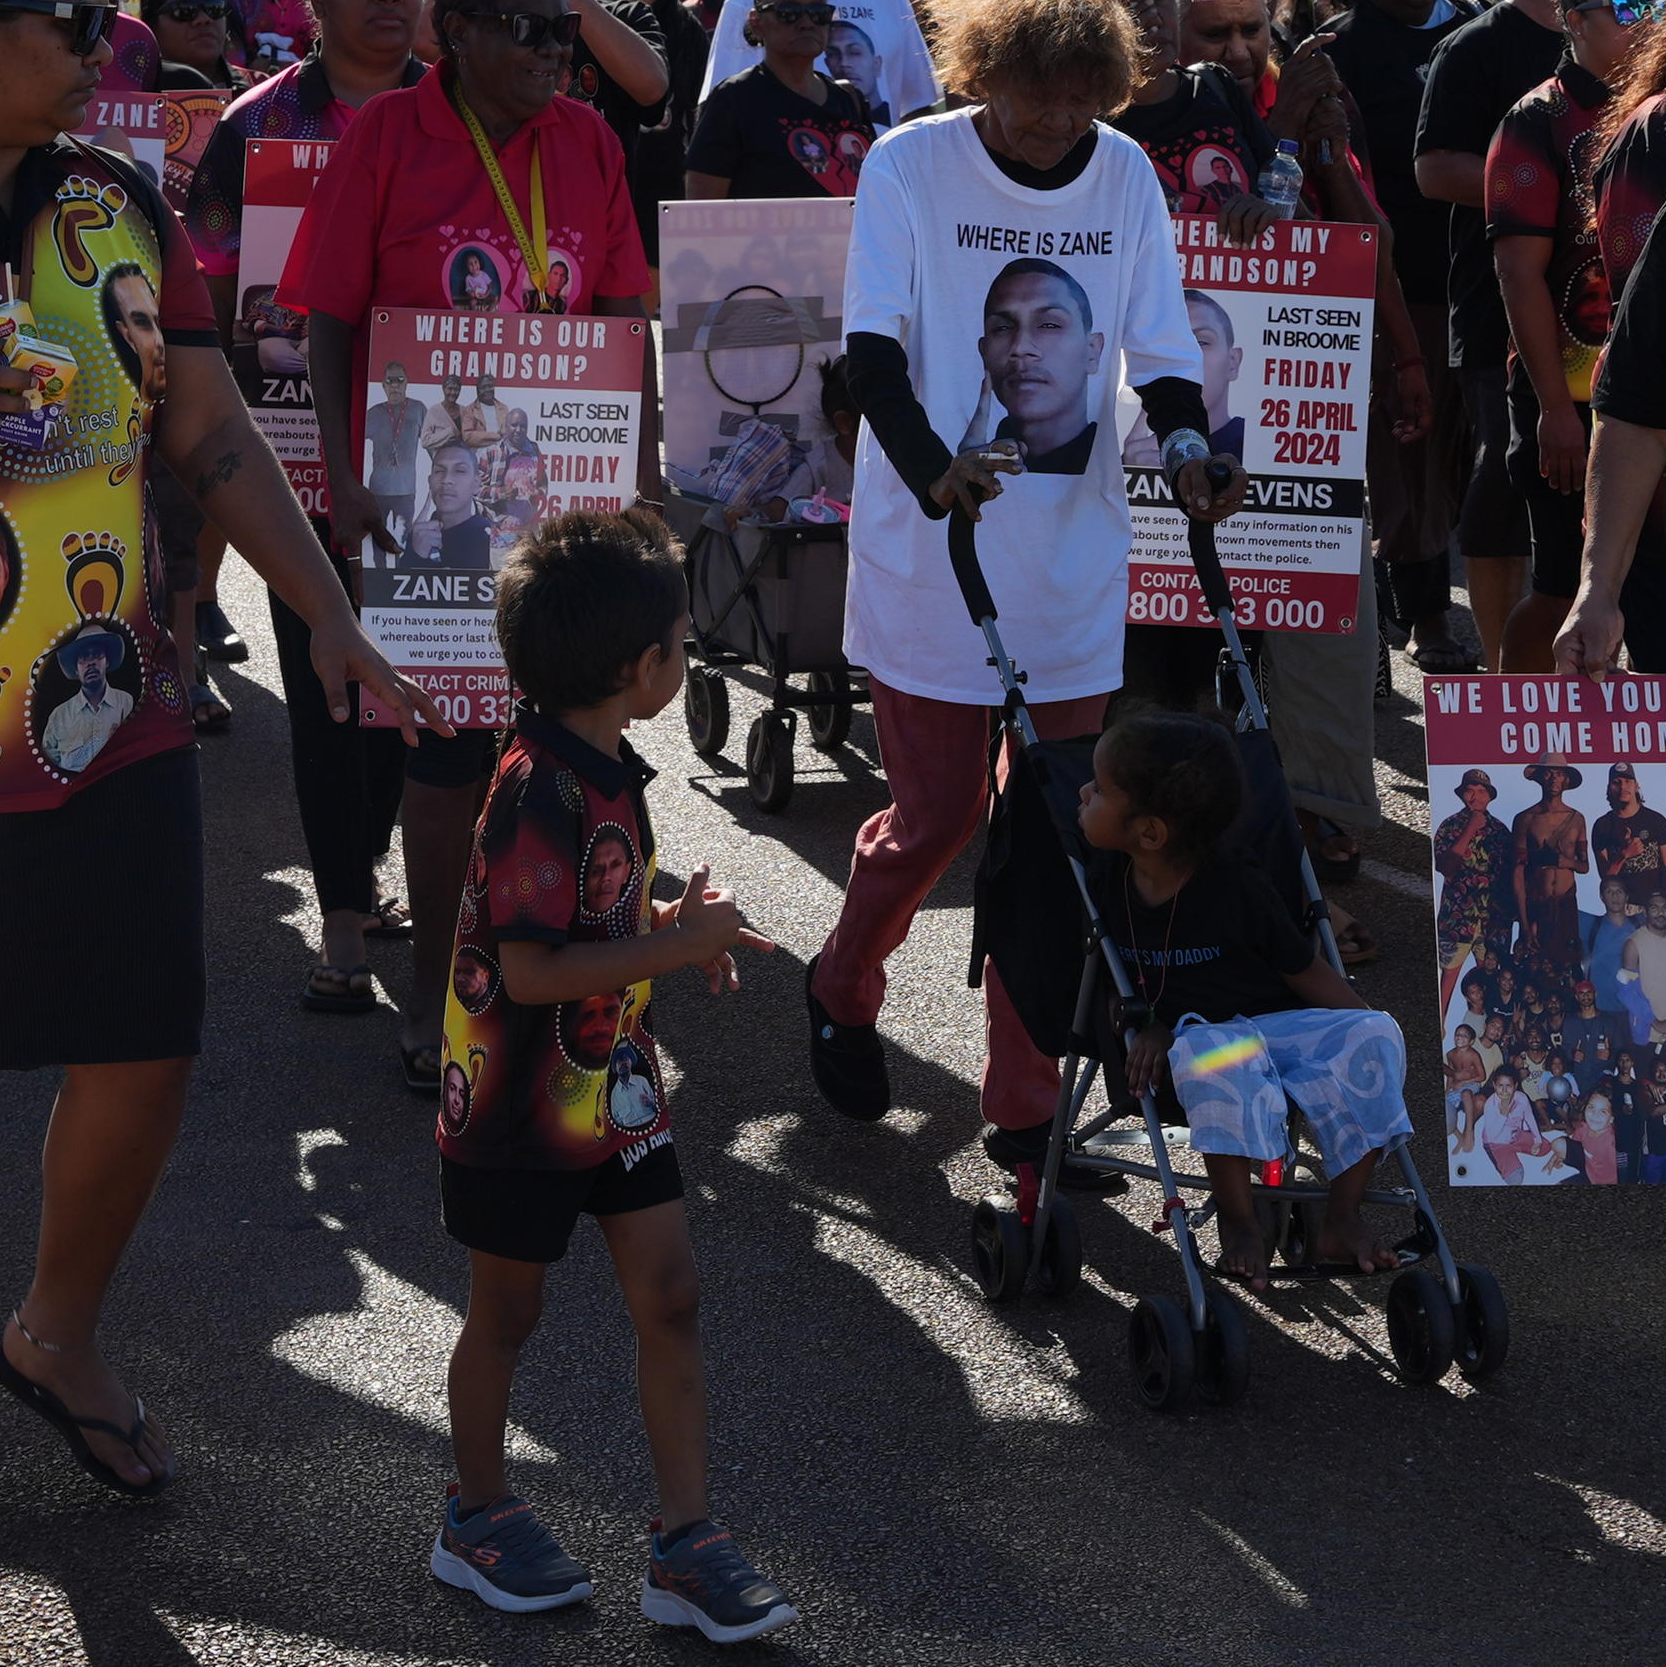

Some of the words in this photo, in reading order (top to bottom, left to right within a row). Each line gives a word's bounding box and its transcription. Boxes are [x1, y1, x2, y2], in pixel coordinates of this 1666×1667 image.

[851, 7, 875, 20] ZANE
[97, 101, 158, 128] ZANE
[957, 224, 1031, 254] WHERE
[1036, 232, 1054, 255] IS
[1059, 232, 1112, 255] ZANE
[1173, 219, 1232, 247] HER
[1291, 226, 1331, 254] MY
[1178, 254, 1317, 286] RANDSON?
[1268, 307, 1312, 324] LAST
[1315, 309, 1361, 328] SEEN
[415, 315, 504, 345] WHERE
[518, 319, 543, 346] IS
[558, 321, 606, 349] OUR
[1262, 330, 1280, 346] IN
[1284, 331, 1361, 351] BROOME
[430, 350, 588, 381] GRANDSON?
[1264, 358, 1352, 390] FRIDAY
[262, 378, 313, 403] ZAN
[5, 415, 26, 425] APPLE
[80, 405, 119, 431] rest
[272, 415, 297, 425] have
[540, 402, 584, 420] LAST
[587, 404, 629, 421] SEEN
[1260, 399, 1290, 427] 26
[1296, 401, 1358, 432] APRIL
[535, 426, 554, 442] IN
[555, 427, 629, 444] BROOME
[45, 446, 95, 474] until
[275, 446, 289, 454] we
[292, 446, 315, 456] urge
[1274, 433, 1341, 465] 2024
[537, 455, 620, 484] FRIDAY
[1124, 474, 1173, 501] ZAN
[1243, 480, 1333, 510] EVENS
[536, 495, 562, 519] 26
[1153, 517, 1179, 526] seen
[1230, 521, 1250, 532] any
[1252, 520, 1317, 533] information
[1320, 525, 1334, 534] on
[1337, 523, 1353, 535] his
[1172, 534, 1184, 542] or
[1248, 537, 1312, 549] movements
[1316, 539, 1340, 550] then
[1145, 549, 1170, 559] urge
[1172, 550, 1194, 560] you
[1255, 553, 1273, 562] the
[1275, 553, 1312, 565] police.
[393, 575, 470, 602] ZANE
[1229, 576, 1291, 595] POLICE
[372, 615, 381, 625] If
[382, 616, 401, 627] you
[405, 615, 430, 626] have
[433, 617, 457, 626] seen
[460, 618, 471, 627] or
[1129, 592, 1188, 622] 800
[1197, 596, 1256, 626] 33
[1266, 599, 1325, 629] 000
[380, 632, 450, 642] whereabouts
[452, 634, 464, 642] or
[466, 633, 485, 643] last
[409, 650, 424, 658] we
[427, 650, 450, 661] urge
[453, 650, 473, 661] you
[475, 650, 487, 659] to
[1437, 682, 1482, 714] WE
[1502, 682, 1582, 713] LOVE
[1600, 681, 1662, 713] YOU
[1501, 722, 1593, 754] COME
[1153, 950, 1173, 966] MY
[1175, 946, 1222, 966] DADDY
